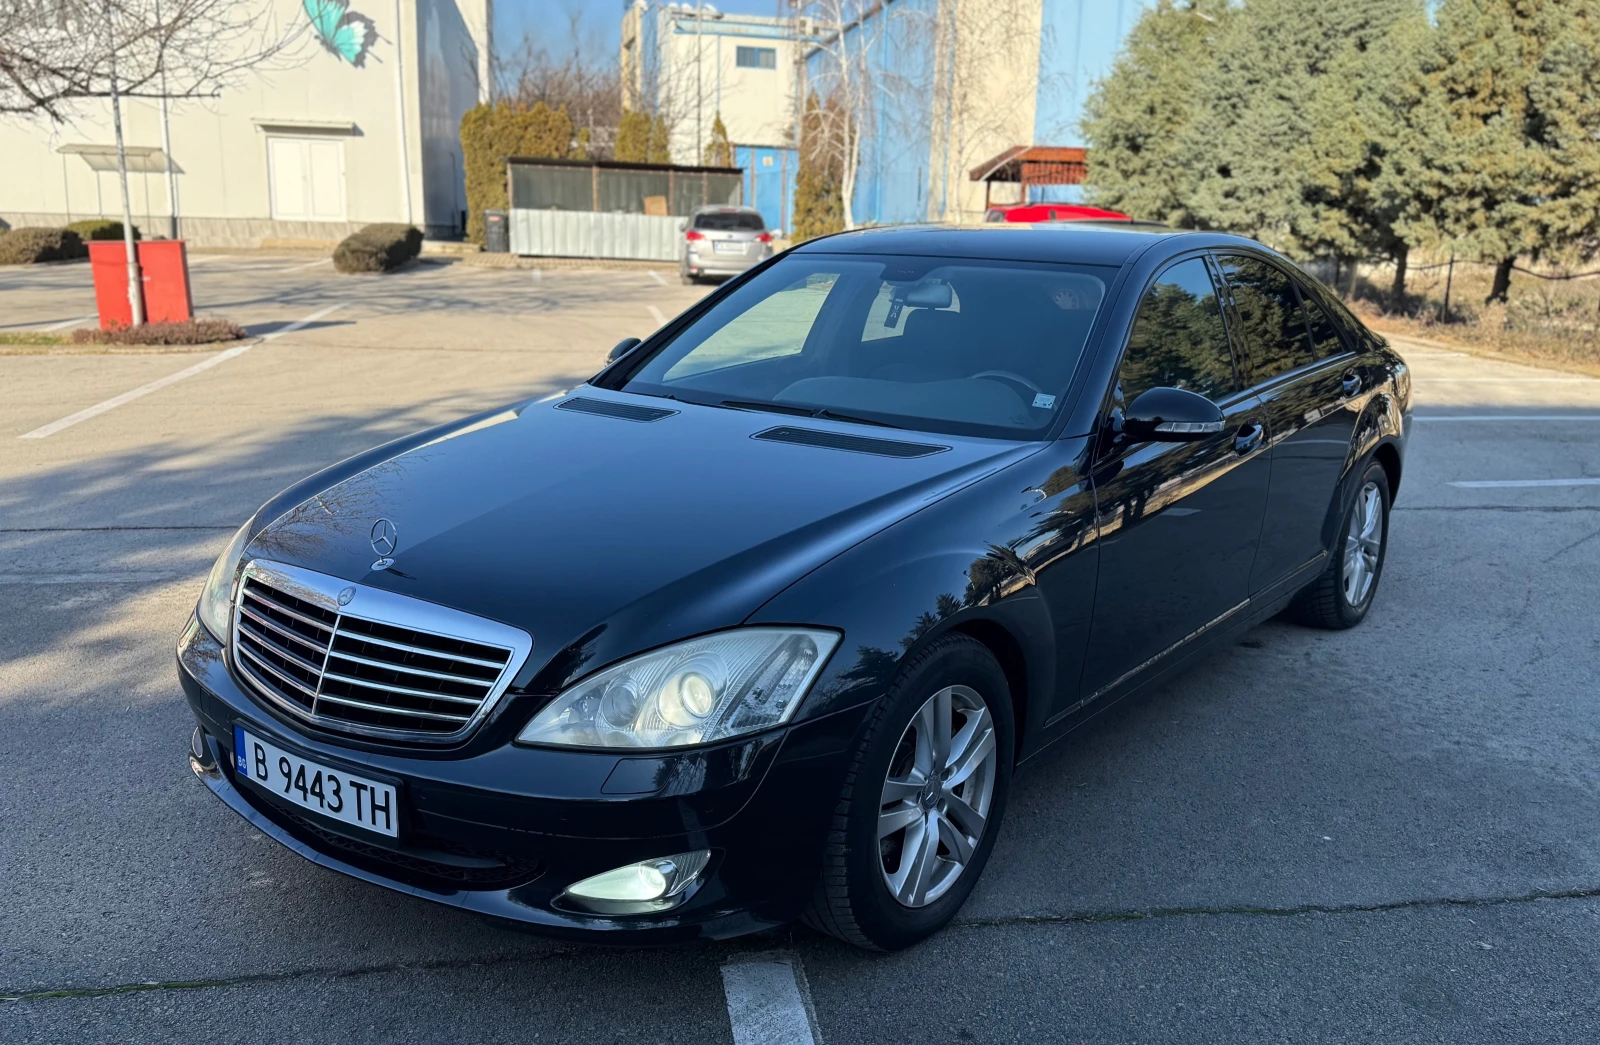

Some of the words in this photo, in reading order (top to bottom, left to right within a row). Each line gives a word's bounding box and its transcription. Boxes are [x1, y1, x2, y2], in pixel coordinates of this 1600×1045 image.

[238, 755, 247, 769] BG
[253, 741, 268, 781] B
[278, 756, 343, 813] 9443
[349, 779, 391, 830] TH
